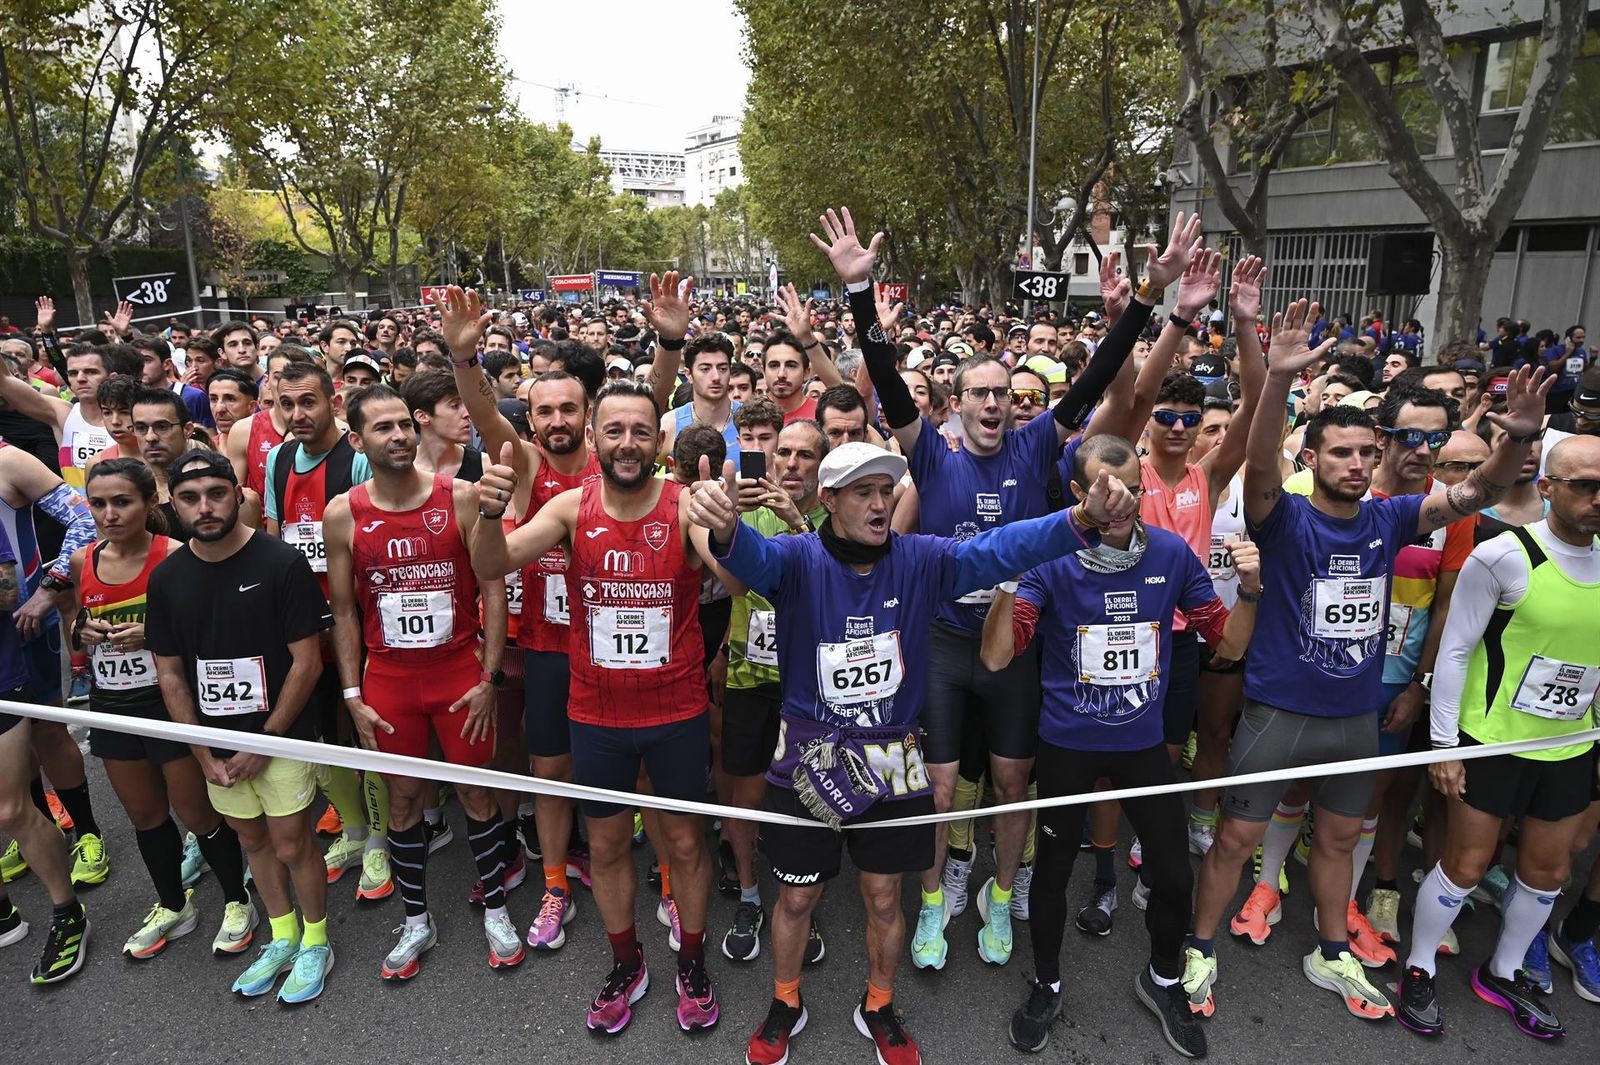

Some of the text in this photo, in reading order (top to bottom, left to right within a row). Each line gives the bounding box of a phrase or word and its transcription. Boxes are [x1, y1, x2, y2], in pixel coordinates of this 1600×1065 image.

[1194, 363, 1214, 374] sky
[389, 562, 454, 581] TECNOCASA
[1145, 576, 1166, 585] HOKA
[601, 582, 671, 599] TECNOCASA
[1325, 601, 1380, 624] 6959
[397, 615, 434, 634] 101
[612, 634, 649, 654] 112
[98, 657, 147, 678] 4745
[1103, 649, 1139, 671] 811
[833, 659, 892, 690] 6267
[1539, 683, 1580, 707] 738
[810, 756, 854, 813] MADRID
[783, 872, 820, 884] RUN
